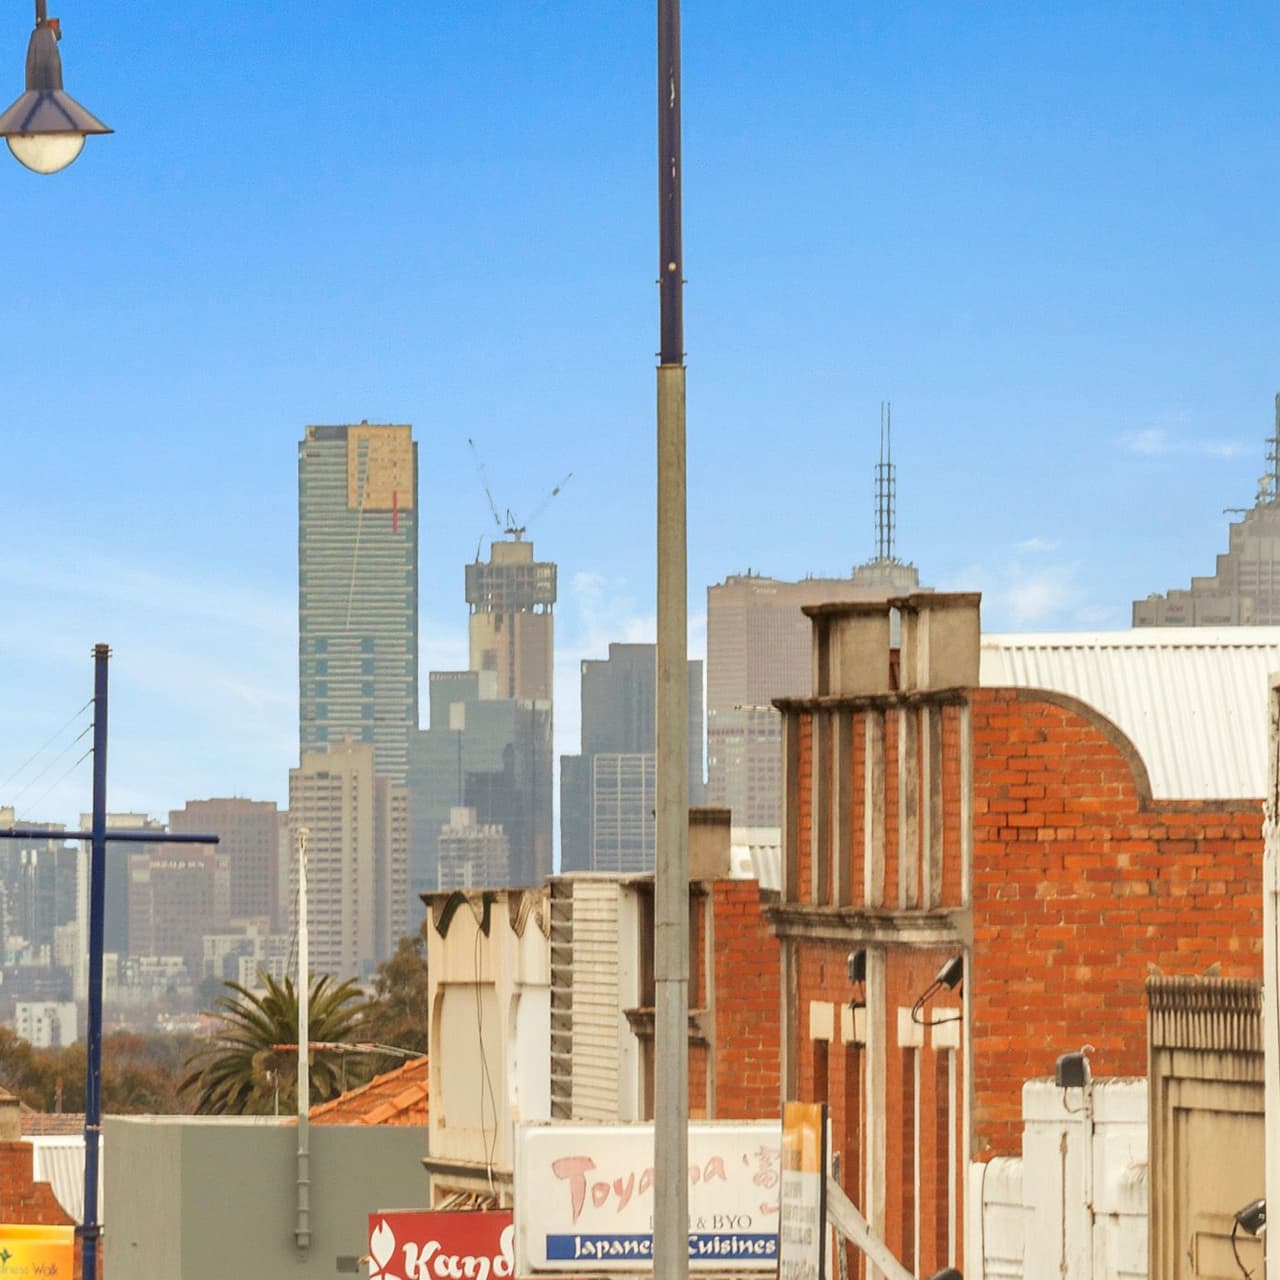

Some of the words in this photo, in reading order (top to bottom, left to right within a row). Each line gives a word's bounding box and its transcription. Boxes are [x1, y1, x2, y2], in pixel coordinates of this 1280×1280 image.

[712, 1215, 753, 1230] BYO
[574, 1236, 655, 1260] Japane
[687, 1235, 777, 1257] Cuisines
